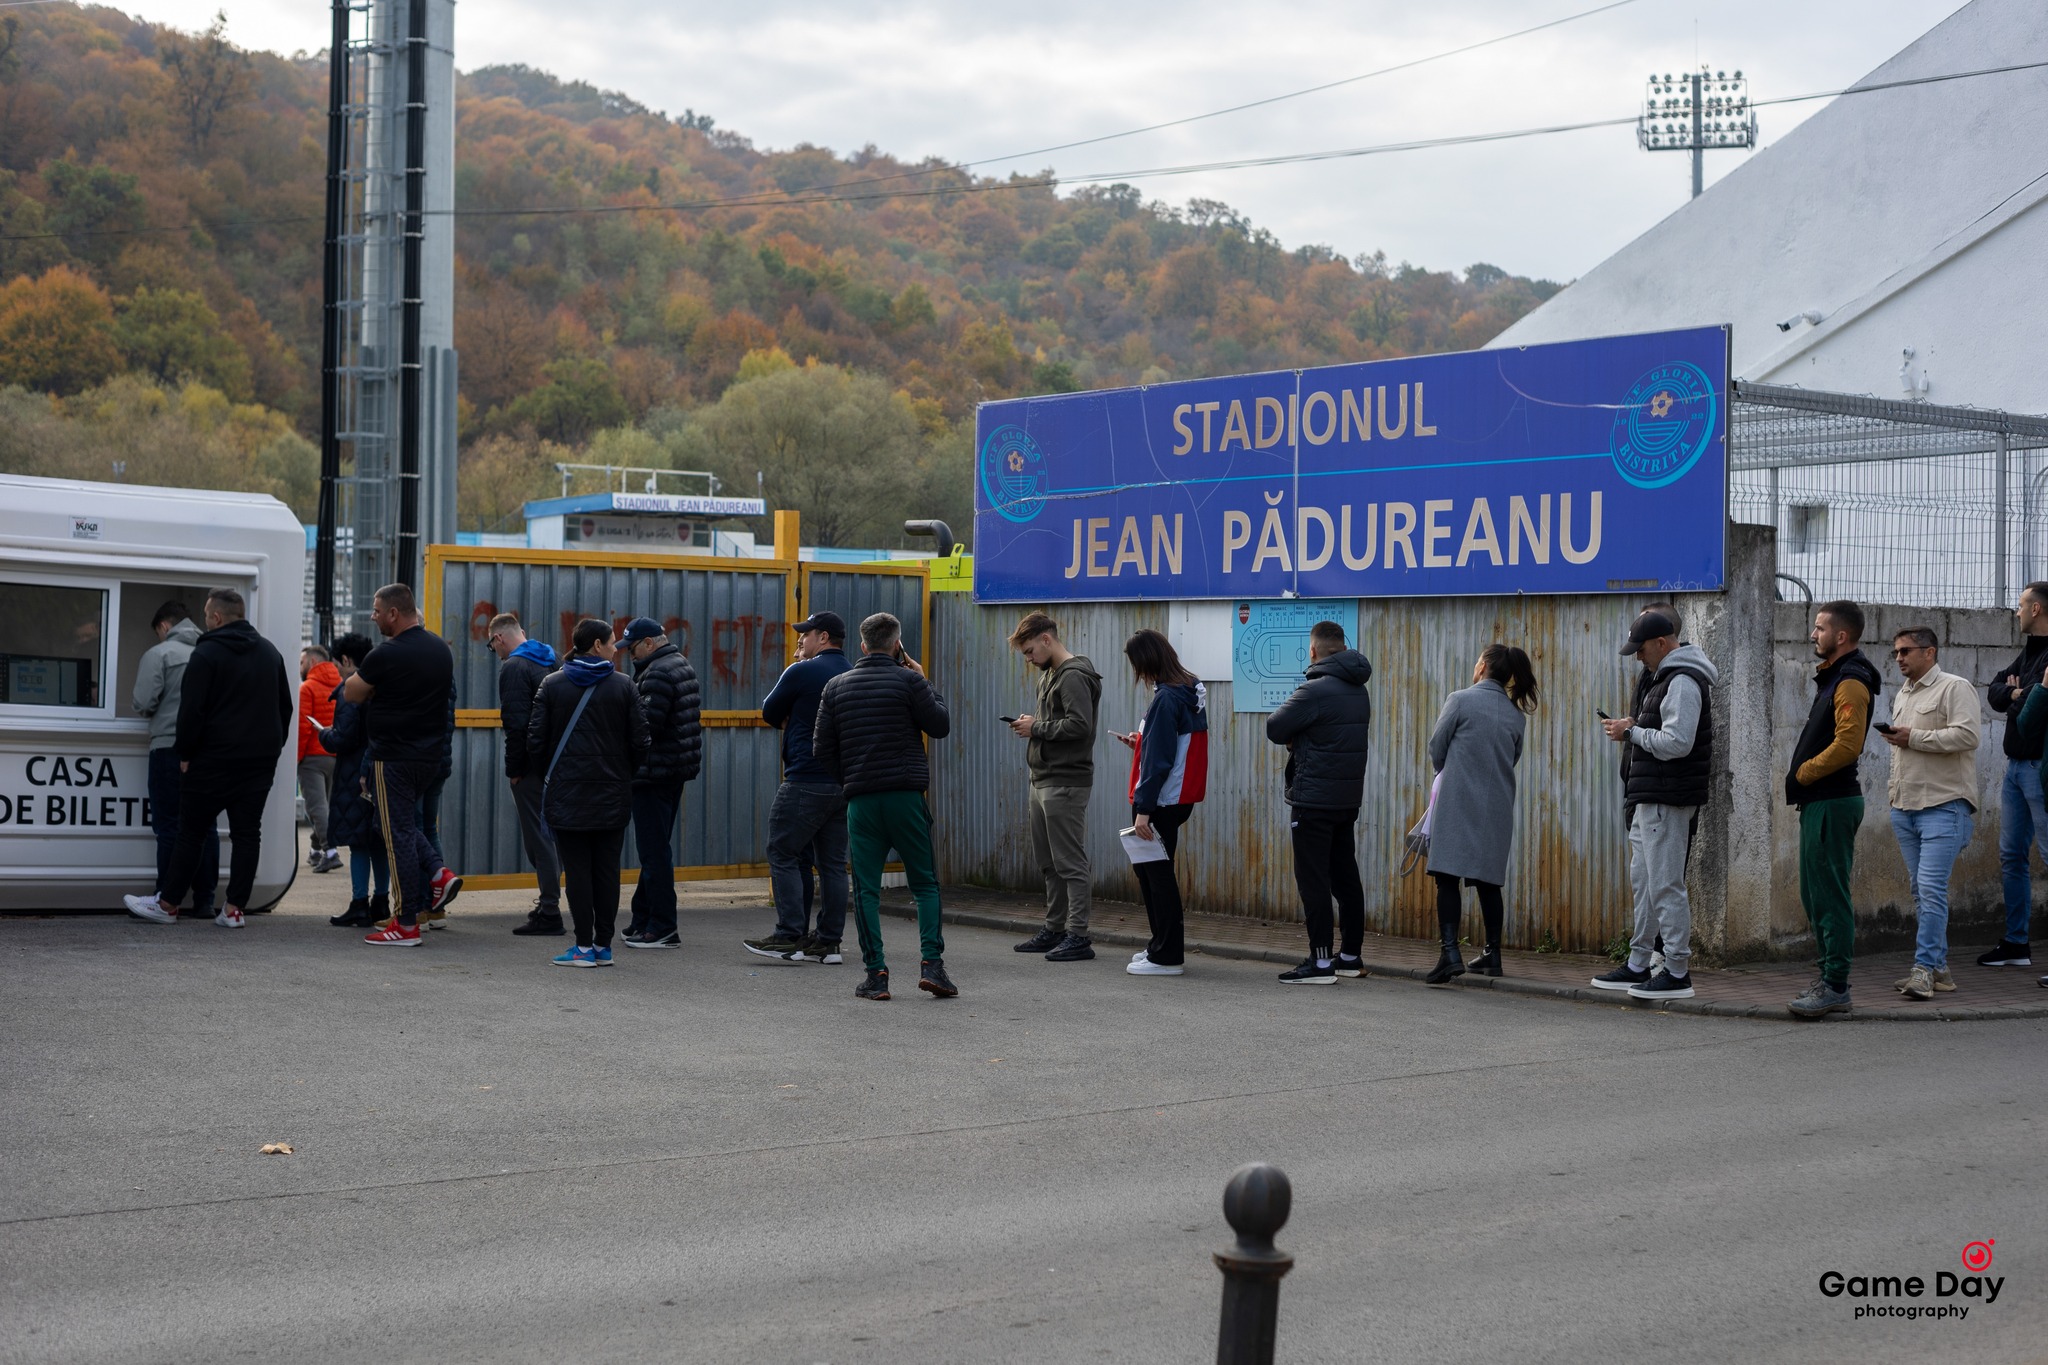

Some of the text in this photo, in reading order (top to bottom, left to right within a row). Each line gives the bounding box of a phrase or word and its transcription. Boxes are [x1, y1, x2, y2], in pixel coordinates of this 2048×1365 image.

[1651, 368, 1702, 404] GLORIA
[1173, 382, 1437, 456] STADIONUL
[616, 496, 672, 511] STADIONUL
[675, 499, 700, 512] JEAN
[1065, 490, 1603, 579] JEAN PĂDUREANU
[25, 756, 118, 787] CASA
